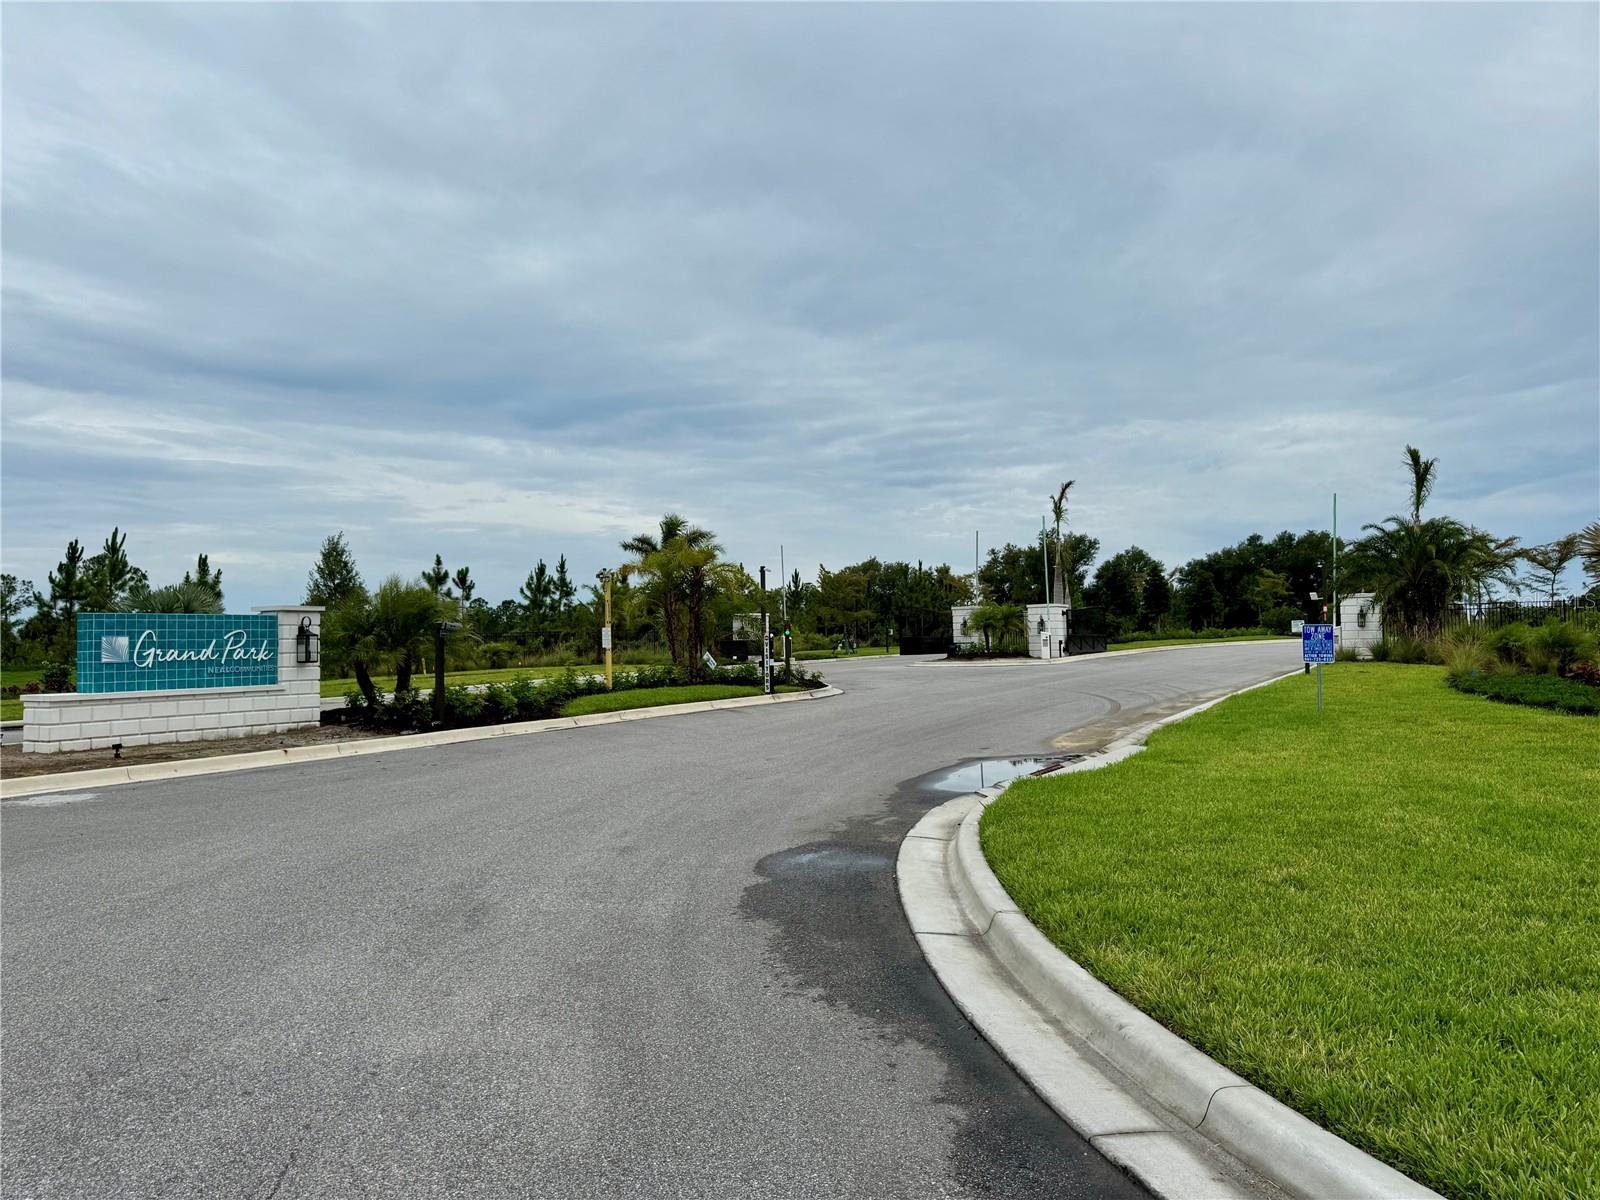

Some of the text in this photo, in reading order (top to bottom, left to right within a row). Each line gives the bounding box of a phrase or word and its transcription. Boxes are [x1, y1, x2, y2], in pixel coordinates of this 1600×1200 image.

[1310, 632, 1326, 640] ZONE
[133, 630, 274, 668] Grand Park
